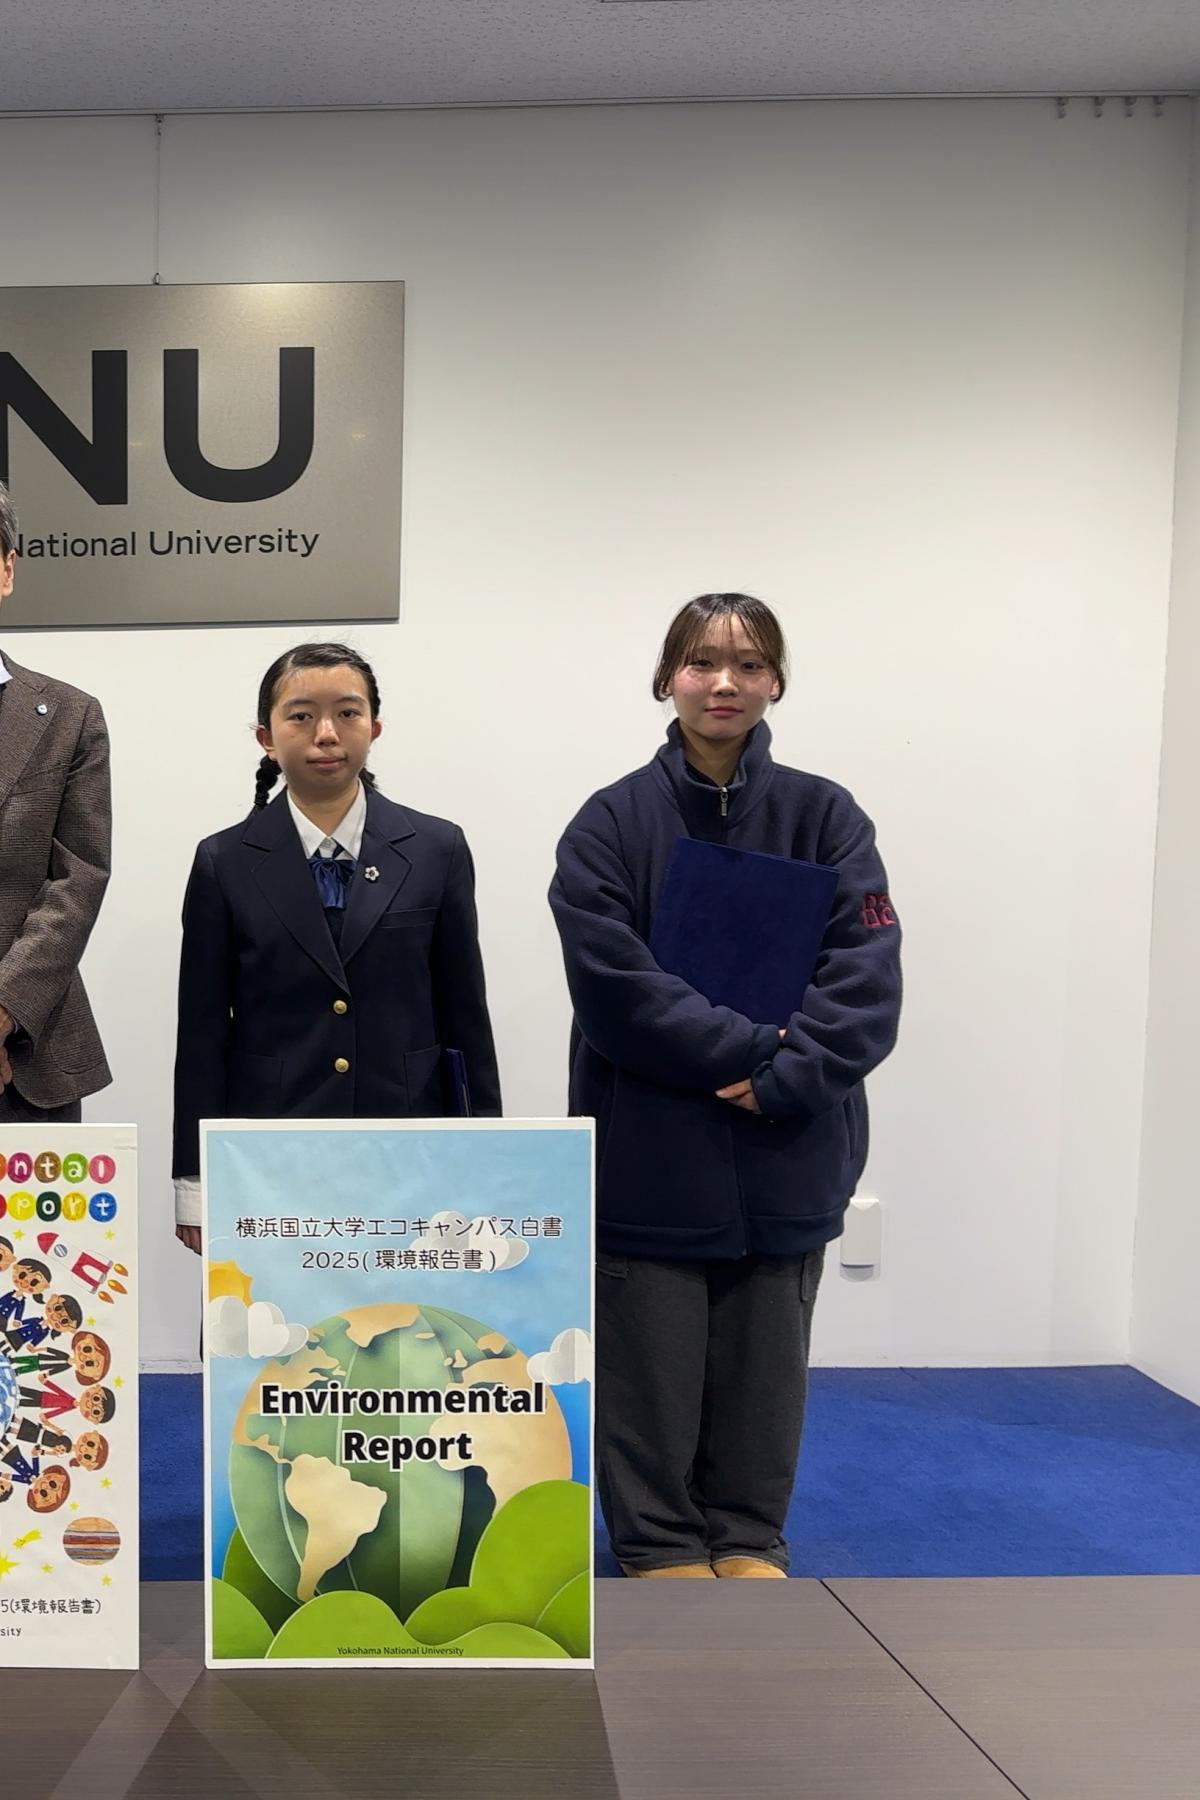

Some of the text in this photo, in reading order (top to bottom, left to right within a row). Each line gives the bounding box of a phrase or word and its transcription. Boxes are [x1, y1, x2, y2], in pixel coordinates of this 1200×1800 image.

[149, 528, 320, 557] University
[236, 1216, 563, 1239] 横浜国立大学エコキャンパス白書
[261, 1381, 545, 1414] Environmental
[343, 1431, 473, 1470] Report
[337, 1647, 464, 1656] Yokohama National University
